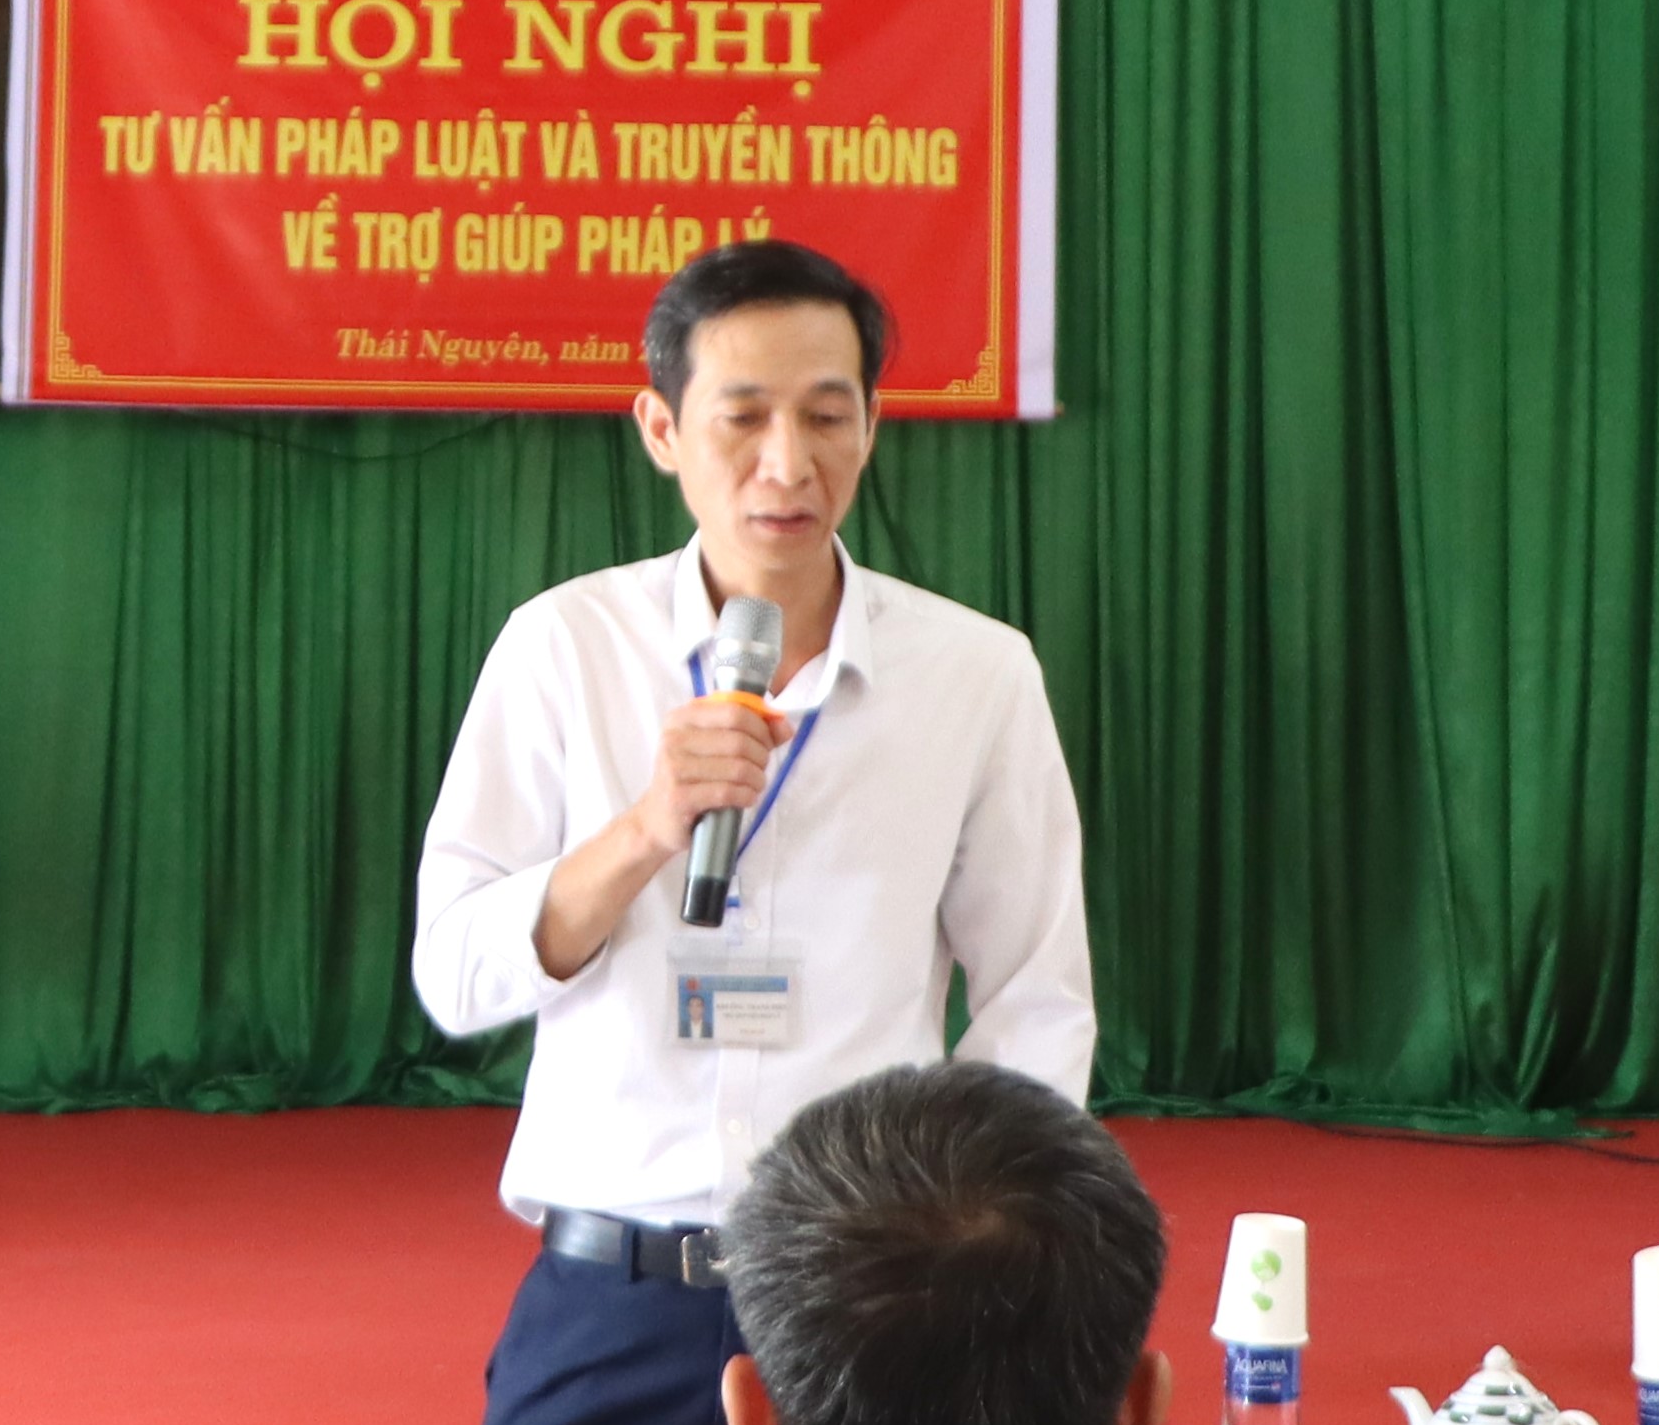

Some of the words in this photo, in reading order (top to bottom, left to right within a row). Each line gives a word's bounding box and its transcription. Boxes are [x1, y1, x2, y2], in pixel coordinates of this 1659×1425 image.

[503, 0, 823, 98] NGHỊ
[100, 110, 159, 175] TƯ
[170, 96, 262, 175] VẤN
[276, 107, 401, 178] PHÁP
[415, 108, 528, 191] LUẬT
[541, 110, 600, 180] VÀ
[614, 105, 792, 184] TRUYỀN
[806, 115, 958, 187] THÔNG
[283, 193, 339, 271] VỀ
[354, 207, 442, 284] TRỢ
[455, 202, 564, 273] GIÚP
[578, 204, 704, 274] PHÁP
[337, 327, 409, 359] Thái
